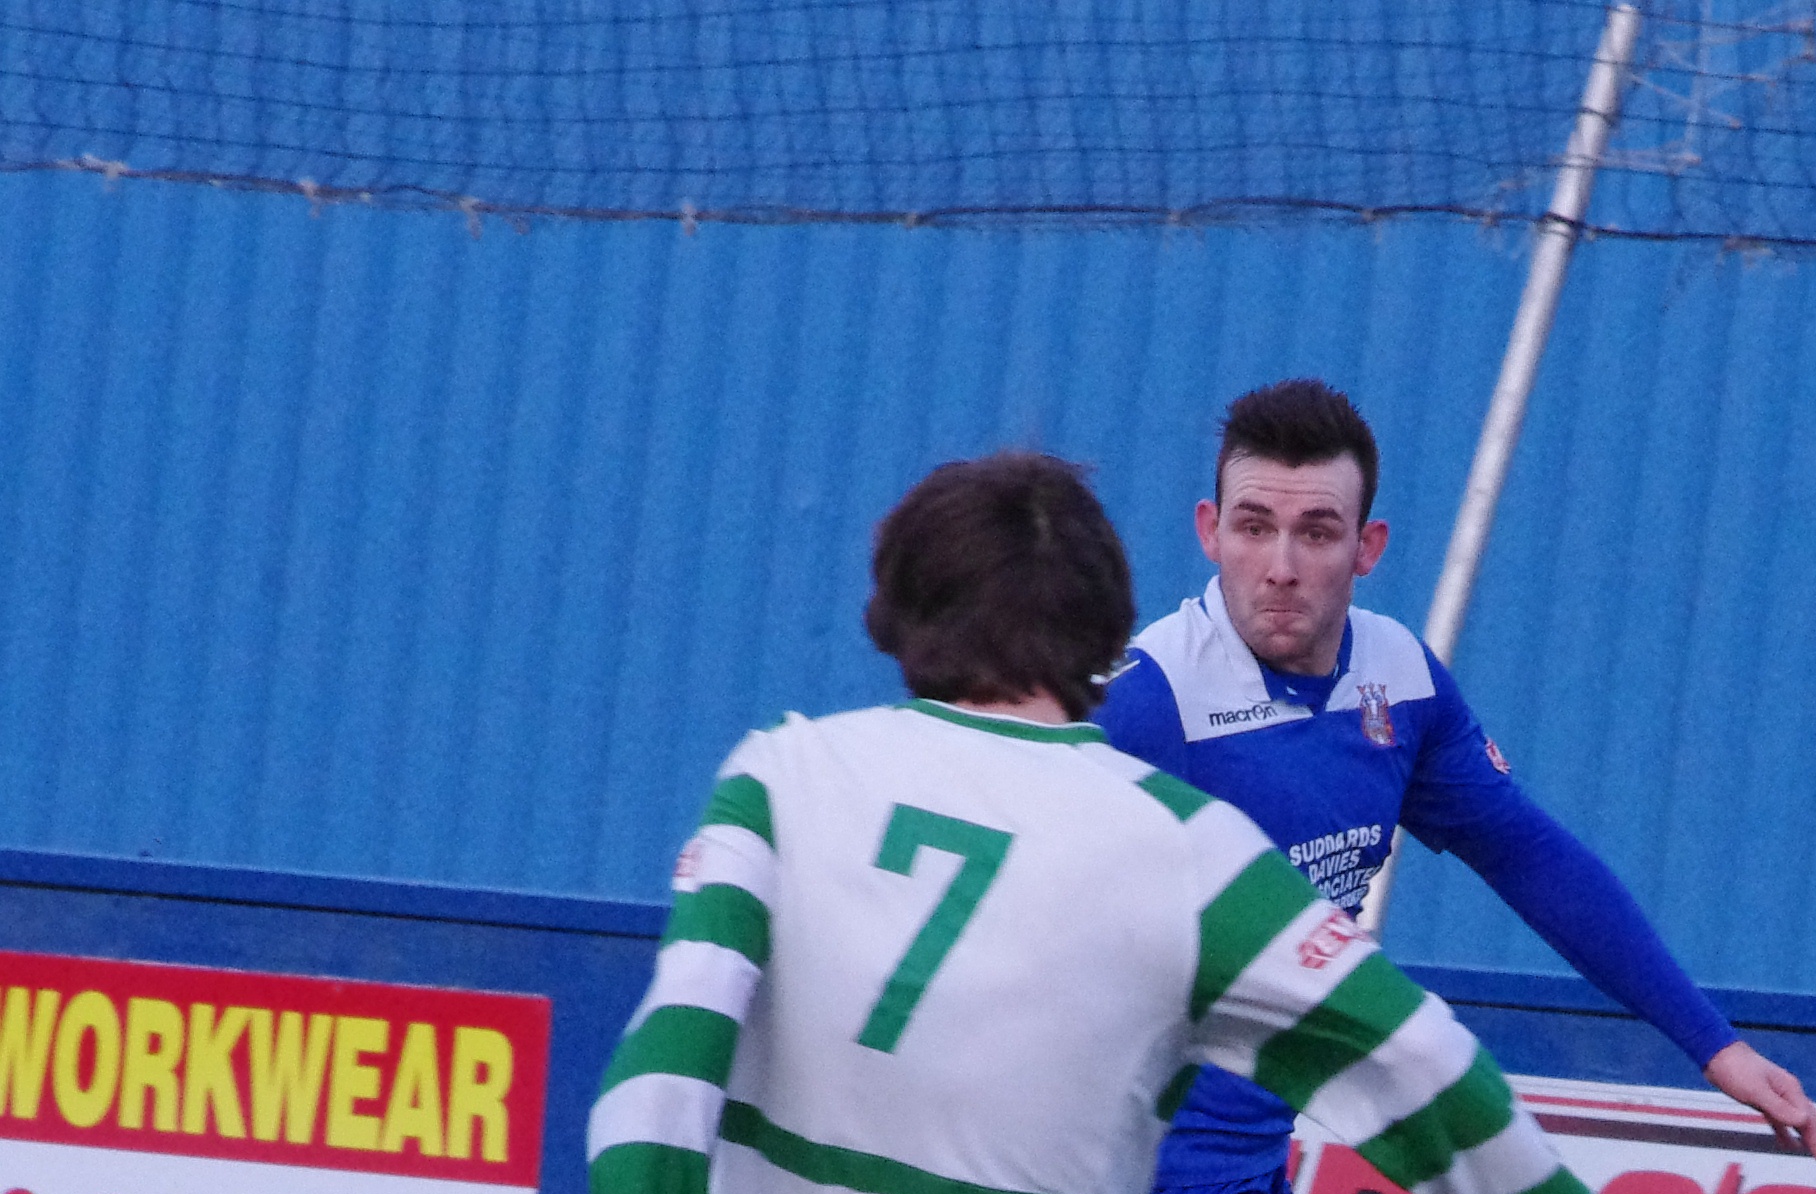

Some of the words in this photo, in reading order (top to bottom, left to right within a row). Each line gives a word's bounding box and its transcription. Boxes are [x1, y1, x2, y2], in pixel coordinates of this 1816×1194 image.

[1208, 704, 1278, 727] macron
[1289, 824, 1382, 867] SUDDARDS
[1308, 849, 1361, 884] DAVIES
[853, 801, 1016, 1055] 7
[0, 985, 514, 1164] WORKWEAR
